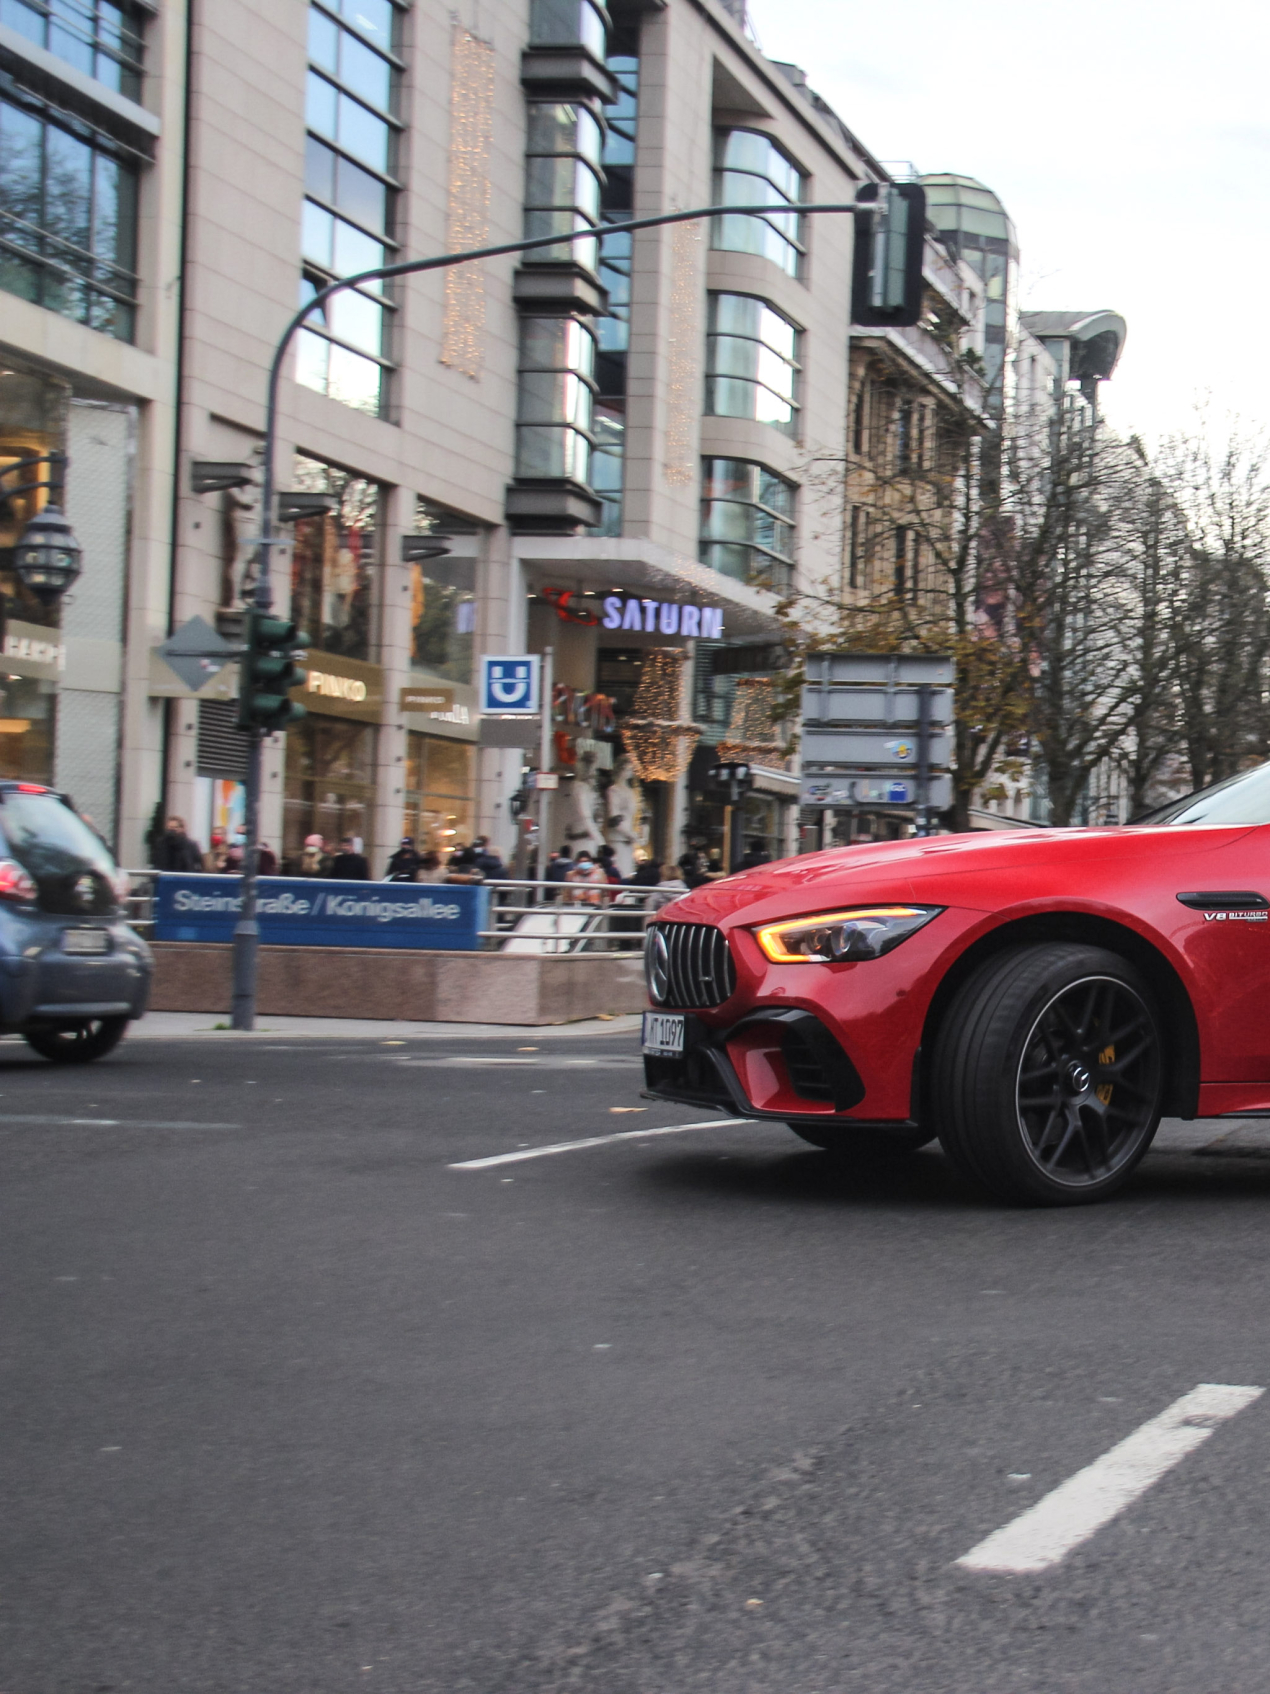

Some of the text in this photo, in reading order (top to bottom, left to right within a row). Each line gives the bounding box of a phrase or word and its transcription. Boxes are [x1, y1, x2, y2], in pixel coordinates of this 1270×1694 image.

[603, 596, 724, 639] SATURN
[173, 889, 311, 915] Steinsraße
[326, 894, 461, 922] Königsallee
[1203, 912, 1227, 921] V8
[660, 1018, 684, 1047] 1097
